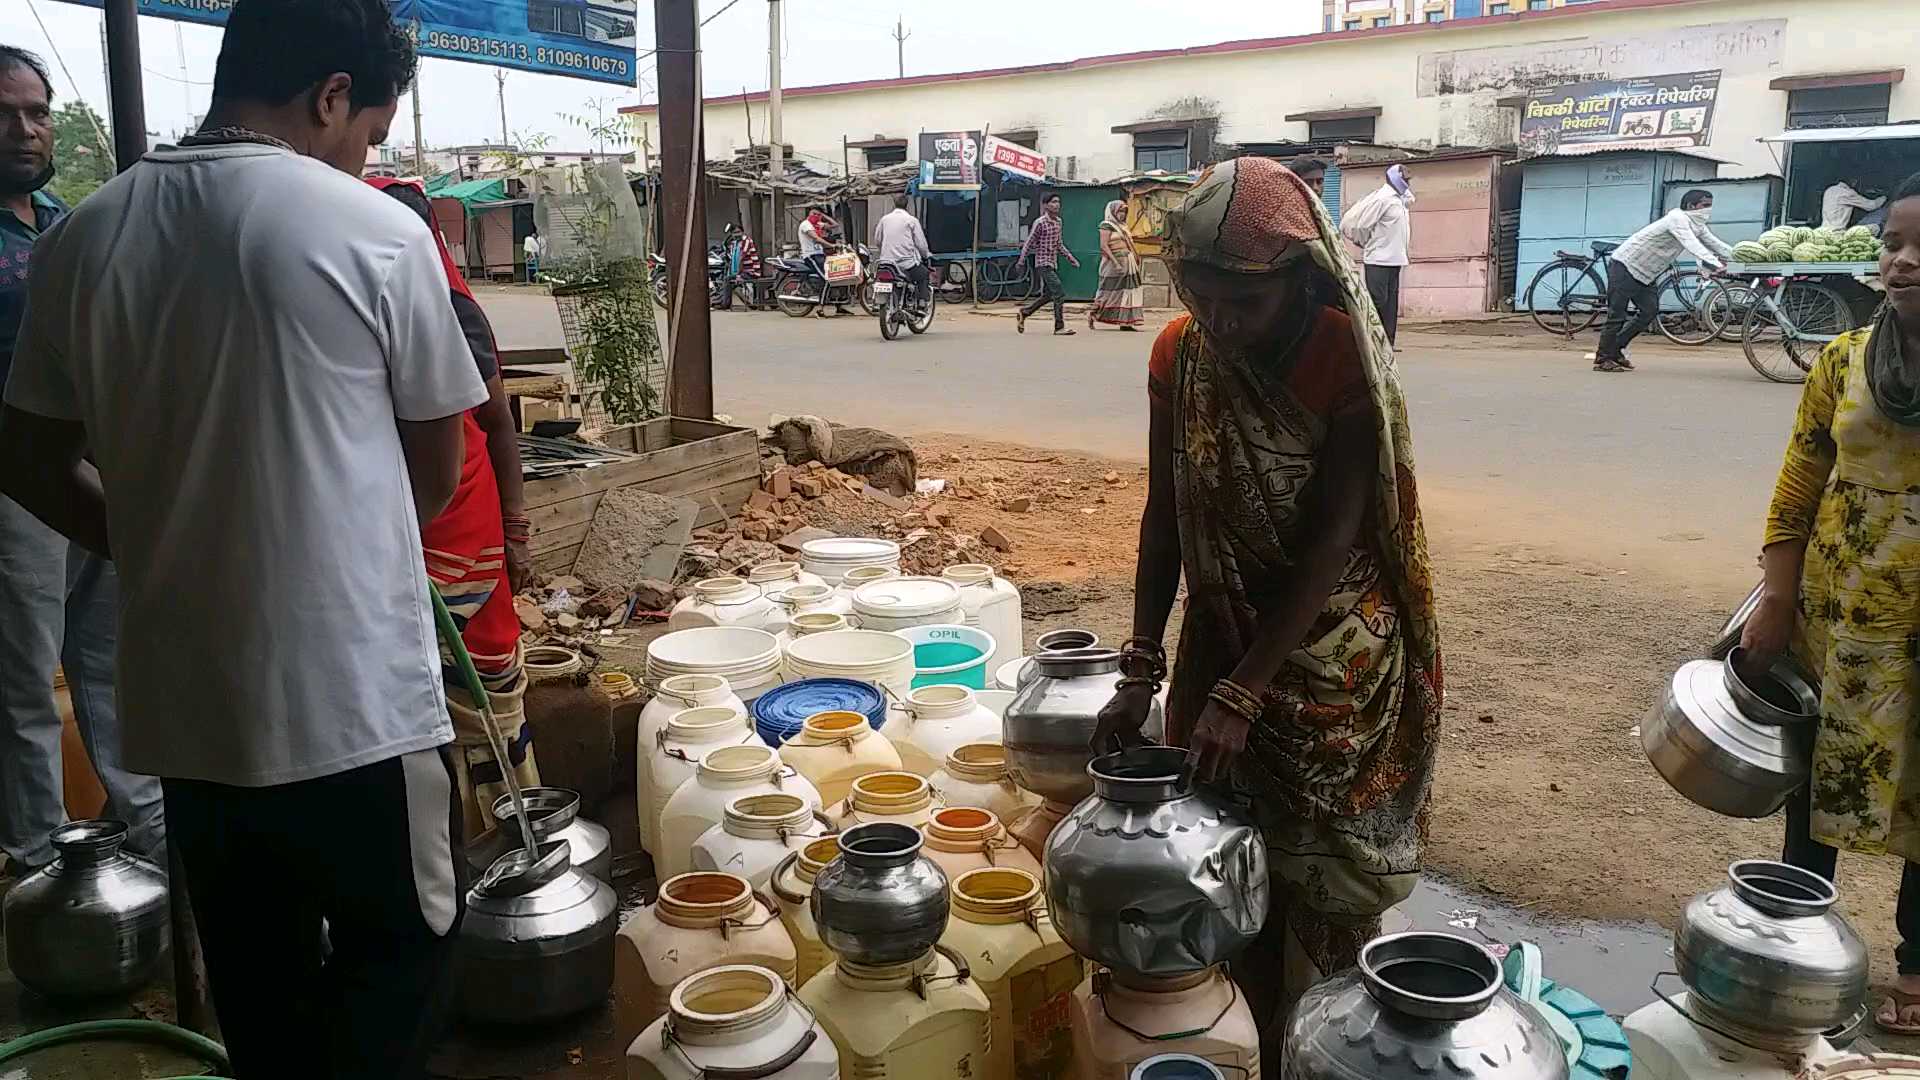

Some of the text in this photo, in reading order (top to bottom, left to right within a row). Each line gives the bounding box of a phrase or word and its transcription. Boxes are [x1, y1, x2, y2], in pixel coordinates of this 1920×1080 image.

[428, 31, 532, 63] 9630315113,
[536, 47, 628, 76] 8109610679
[928, 629, 961, 640] OPIL
